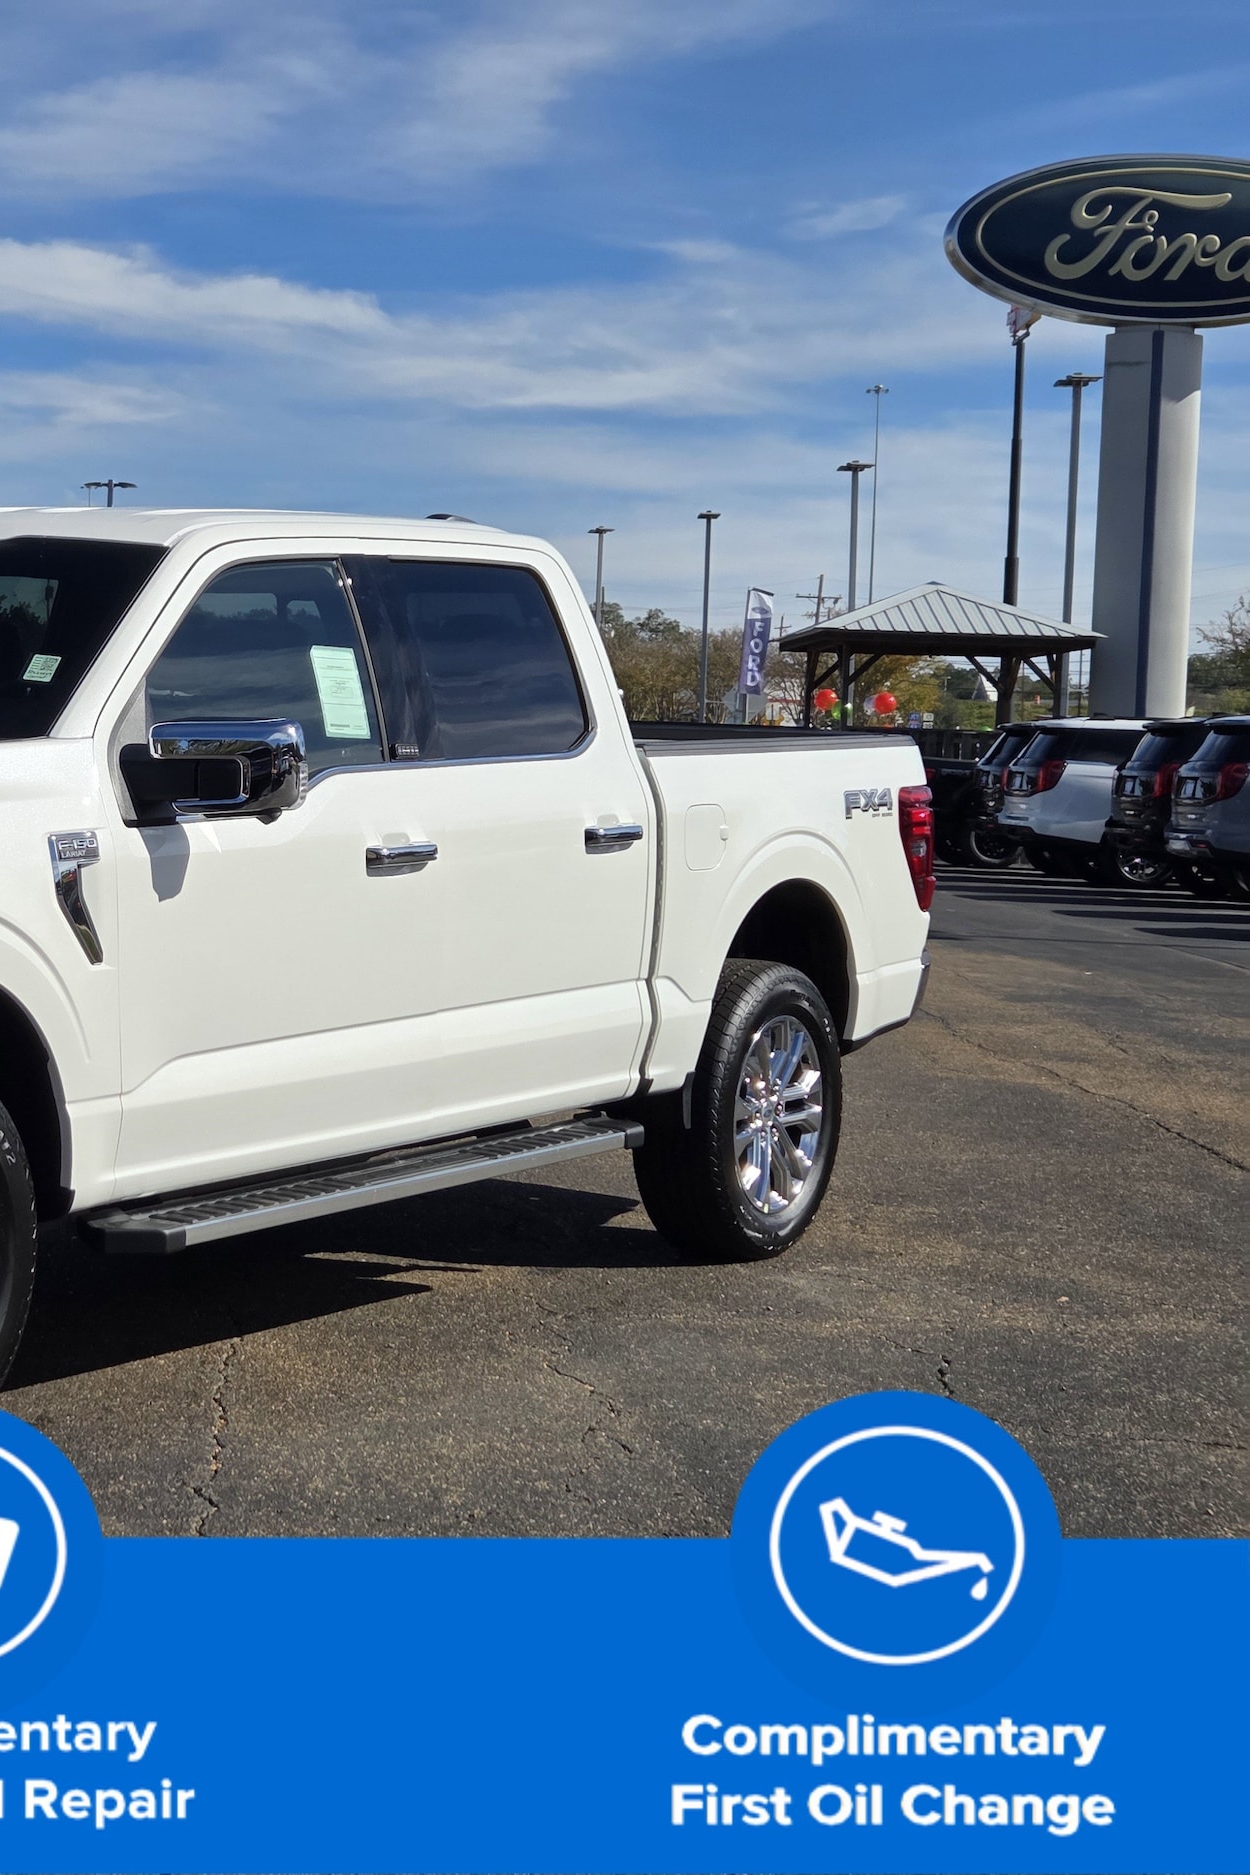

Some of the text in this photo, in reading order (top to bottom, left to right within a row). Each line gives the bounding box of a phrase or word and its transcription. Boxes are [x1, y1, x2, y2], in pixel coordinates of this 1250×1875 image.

[747, 621, 765, 687] FORD
[844, 788, 893, 819] FX4
[58, 838, 97, 850] F-150
[60, 850, 87, 858] LARIAT
